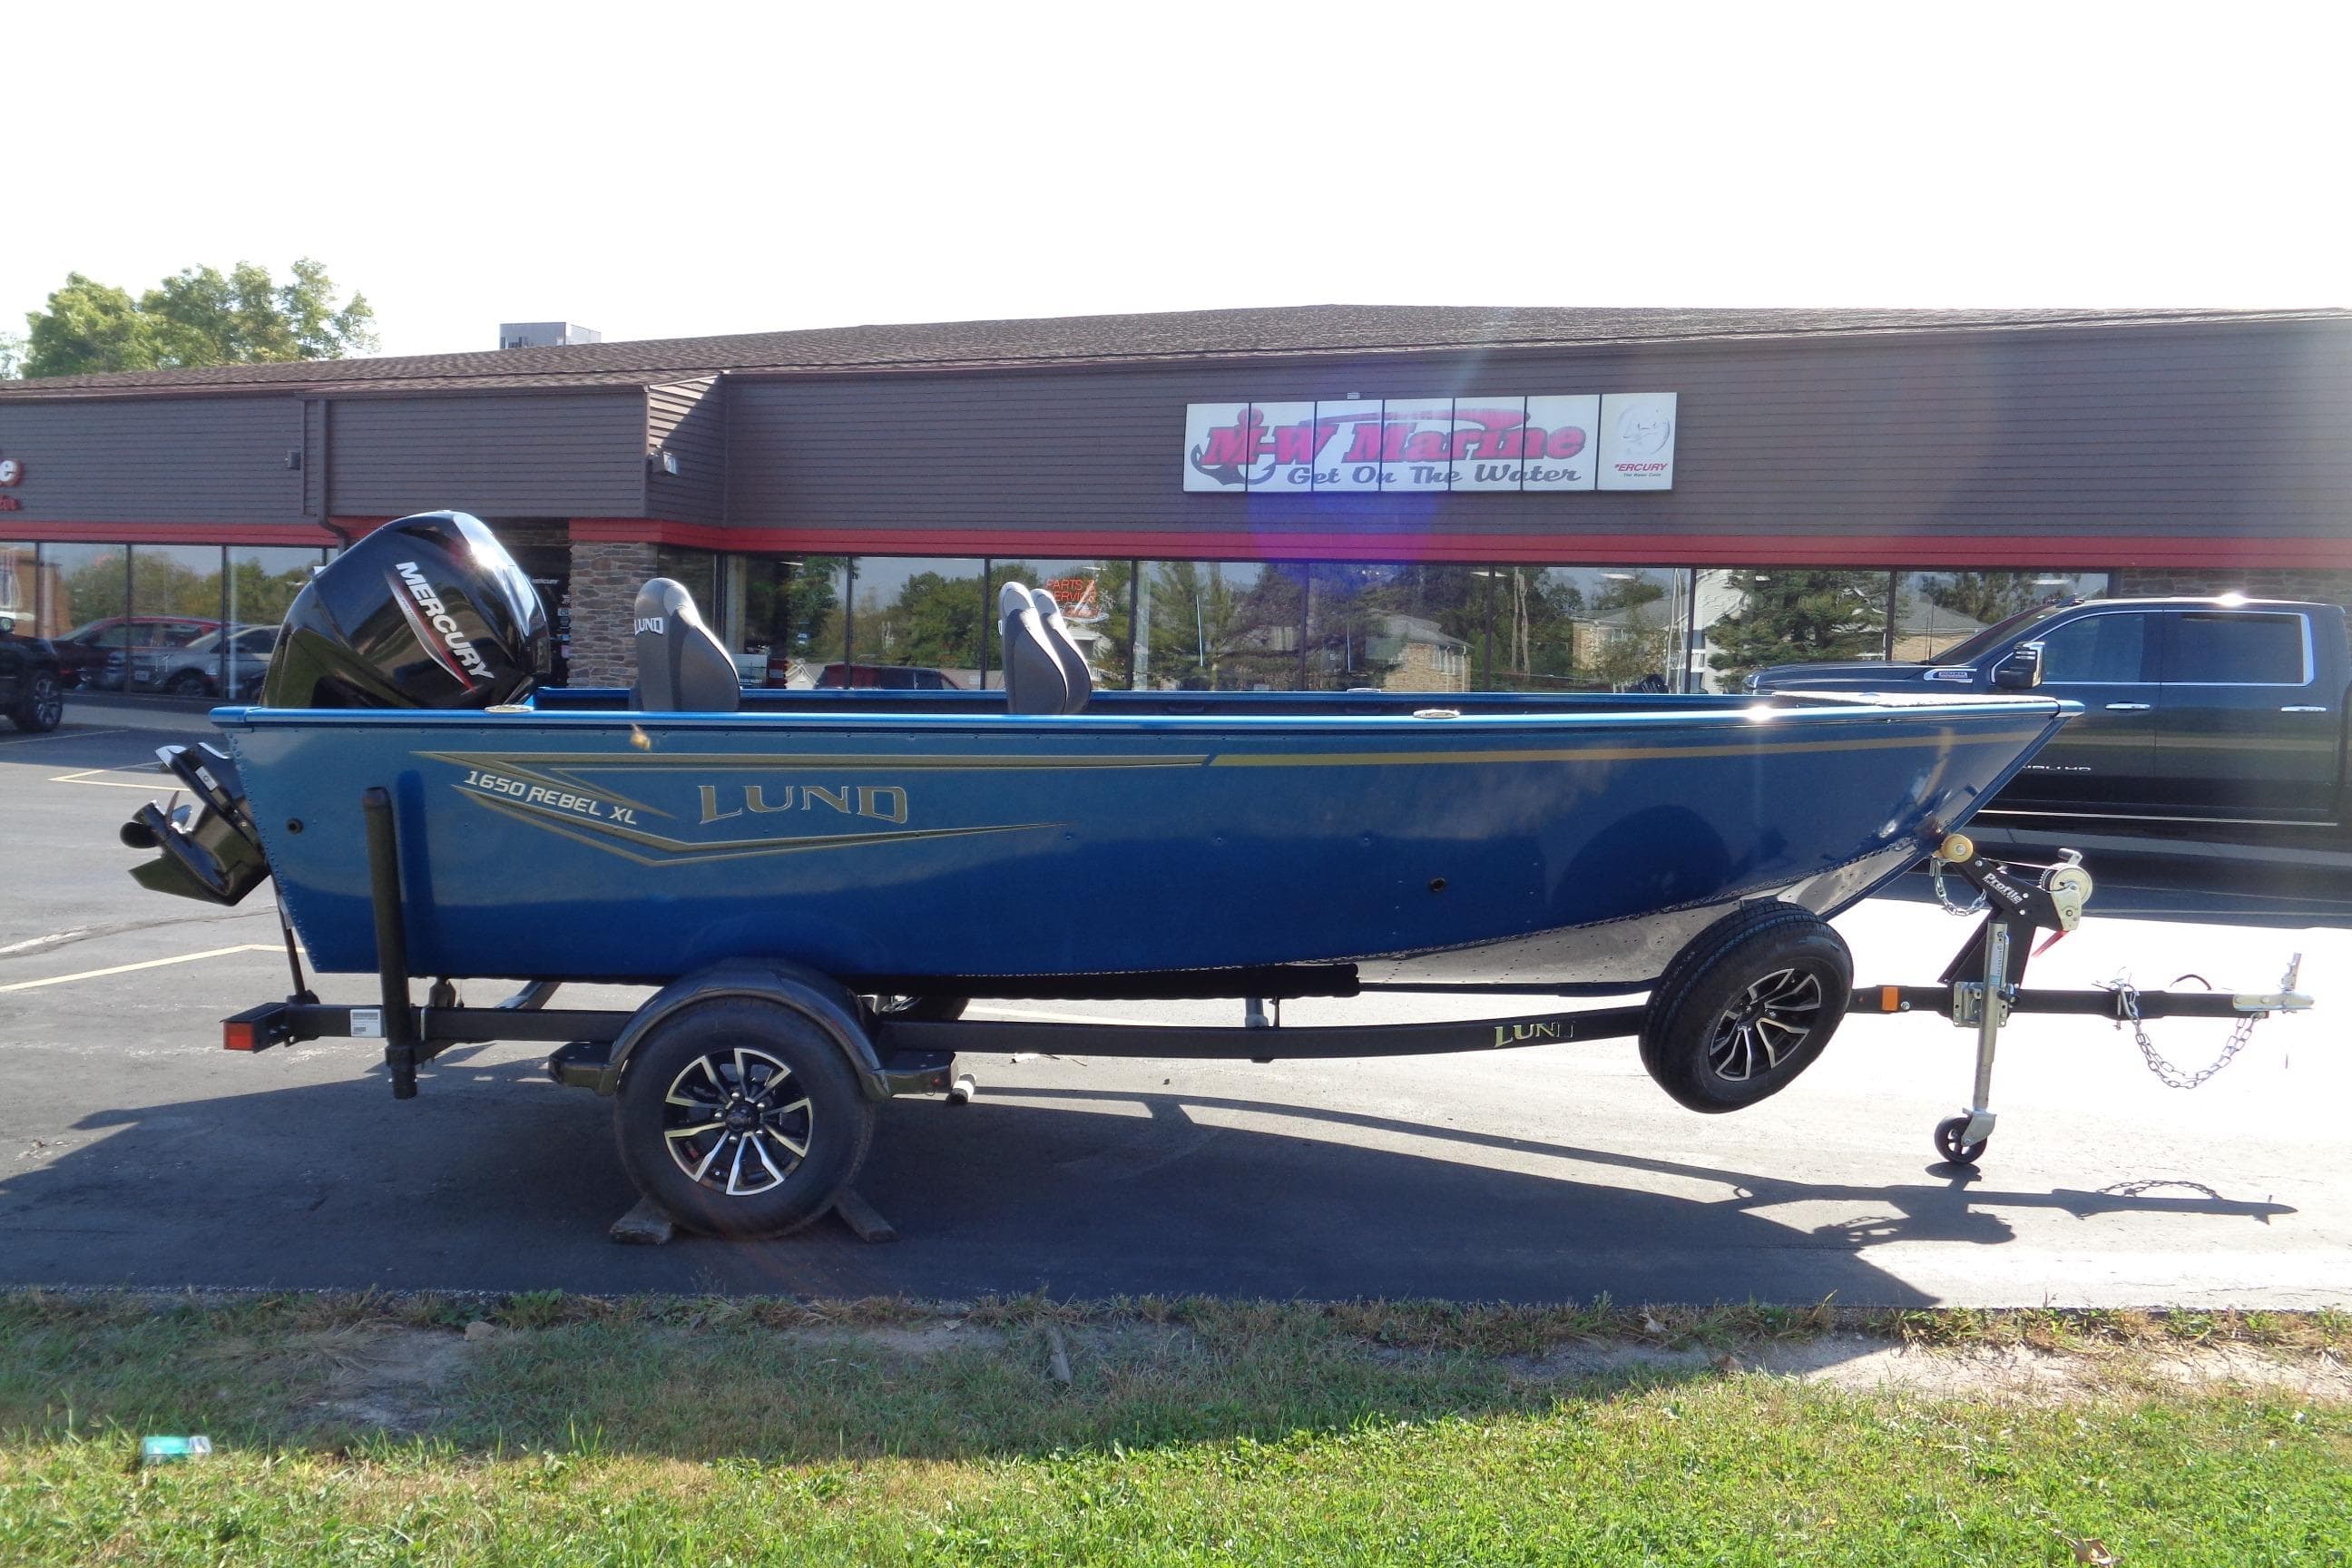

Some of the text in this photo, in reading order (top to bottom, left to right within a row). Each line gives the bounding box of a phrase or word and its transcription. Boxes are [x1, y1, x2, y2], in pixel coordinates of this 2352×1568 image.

[1341, 421, 1586, 464] Marine
[1287, 463, 1582, 485] Get On The Water
[1045, 579, 1083, 591] PARTS
[396, 562, 495, 679] MERCURY
[633, 616, 663, 635] LUND
[464, 770, 637, 825] 1650 REBEL XL
[697, 785, 907, 825] LUND
[1983, 872, 2024, 905] Profile
